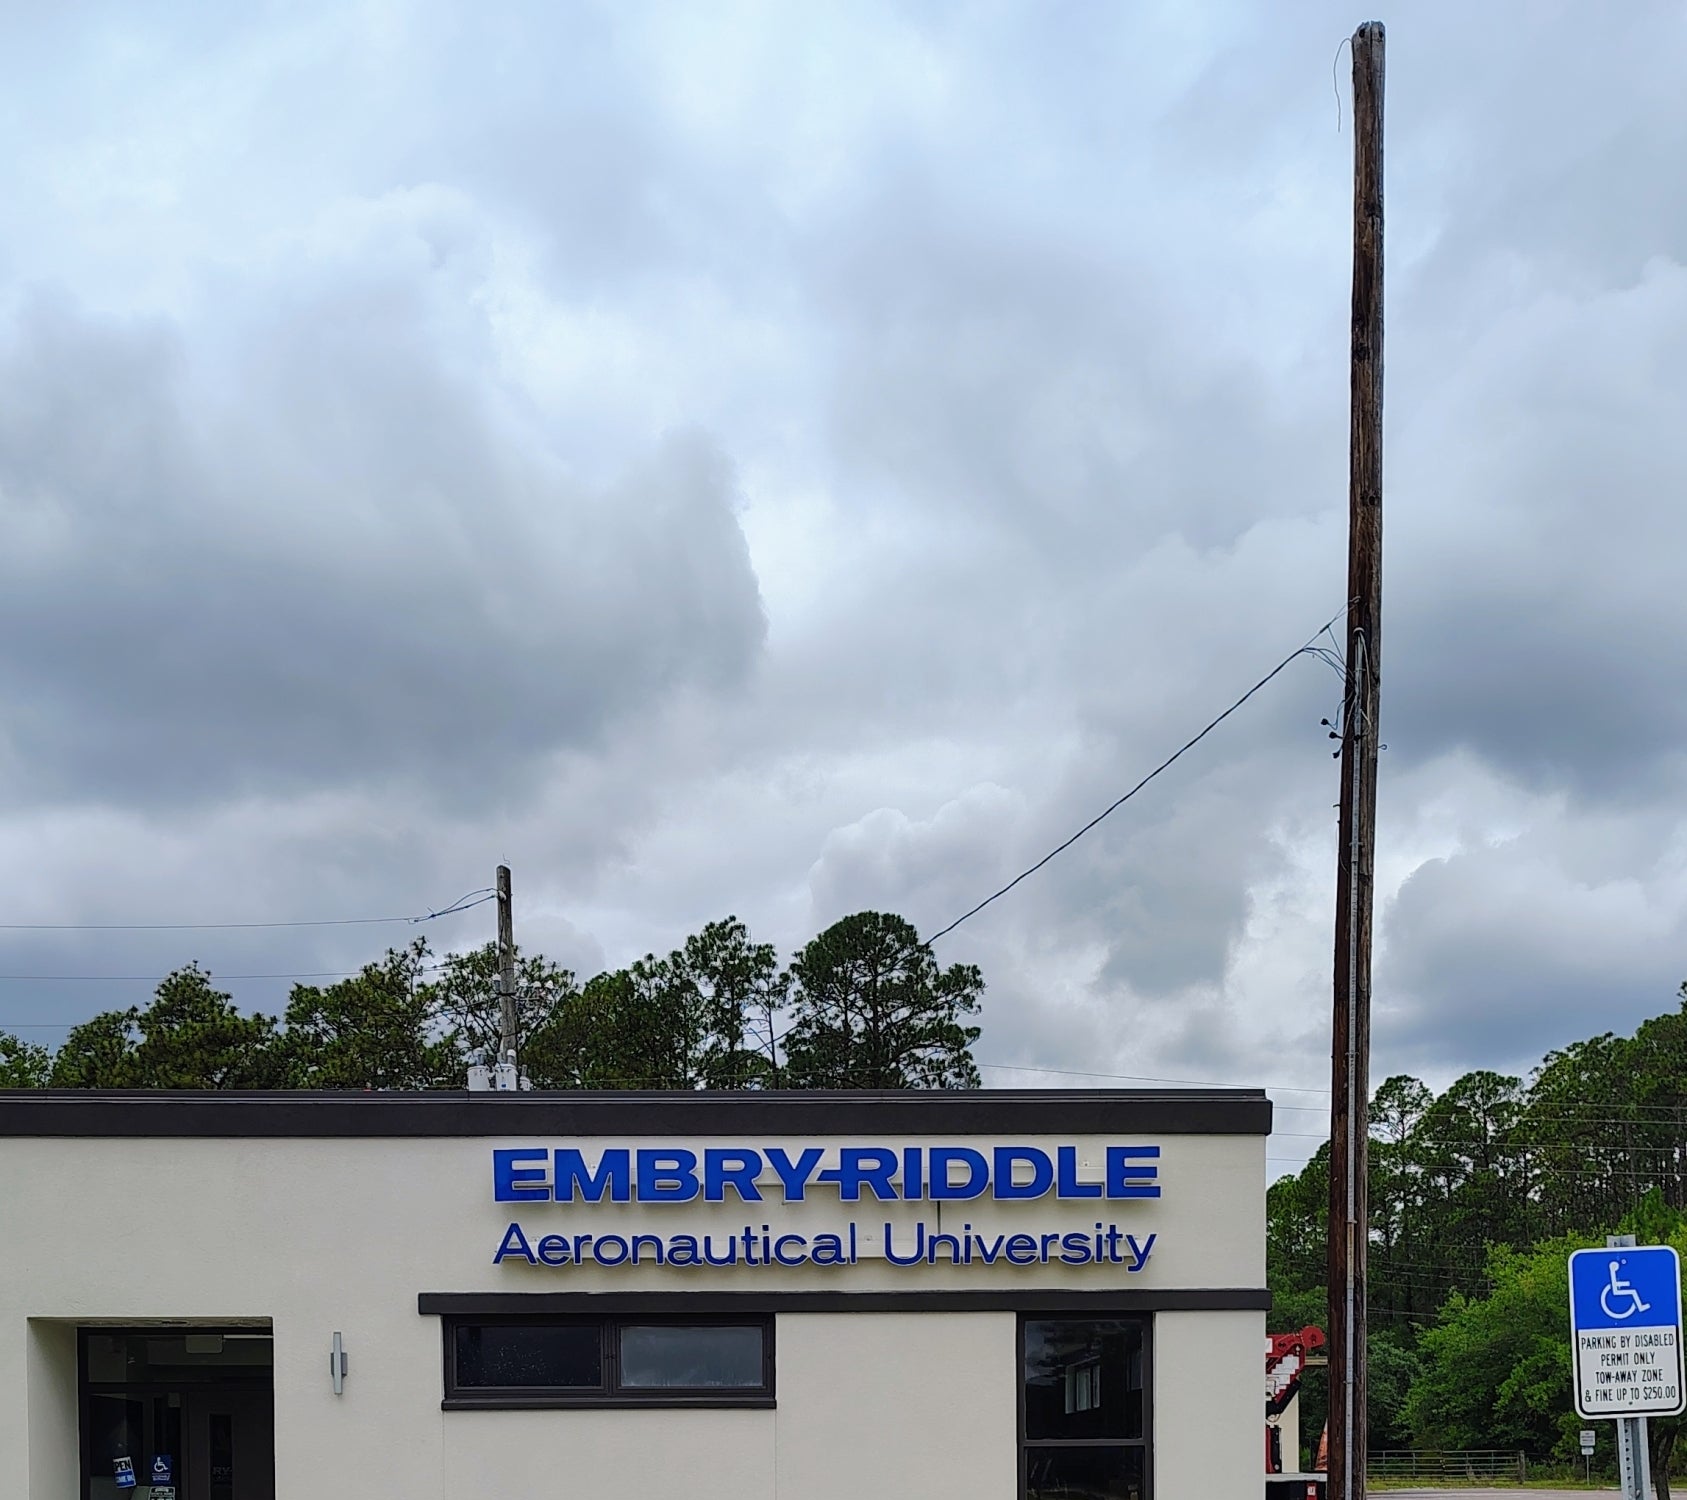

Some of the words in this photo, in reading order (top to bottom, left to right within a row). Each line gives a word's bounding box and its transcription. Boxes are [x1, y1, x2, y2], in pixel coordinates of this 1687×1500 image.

[493, 1146, 1162, 1203] EMBRY-RIDDLE
[493, 1221, 856, 1267] Aeronautical
[885, 1221, 1157, 1272] University
[1581, 1336, 1617, 1350] PARKING
[1621, 1335, 1631, 1348] BY
[1635, 1333, 1674, 1347] DISABLED
[1601, 1352, 1629, 1366] PERMIT
[1634, 1352, 1655, 1365] ONLY
[1595, 1370, 1637, 1384] TOW-AWAY
[1642, 1369, 1663, 1382] ZONE
[1585, 1390, 1592, 1402] &
[1595, 1389, 1613, 1402] FINE
[1617, 1388, 1627, 1401] UP
[1630, 1387, 1640, 1400] TO
[1643, 1386, 1676, 1400] $250.00
